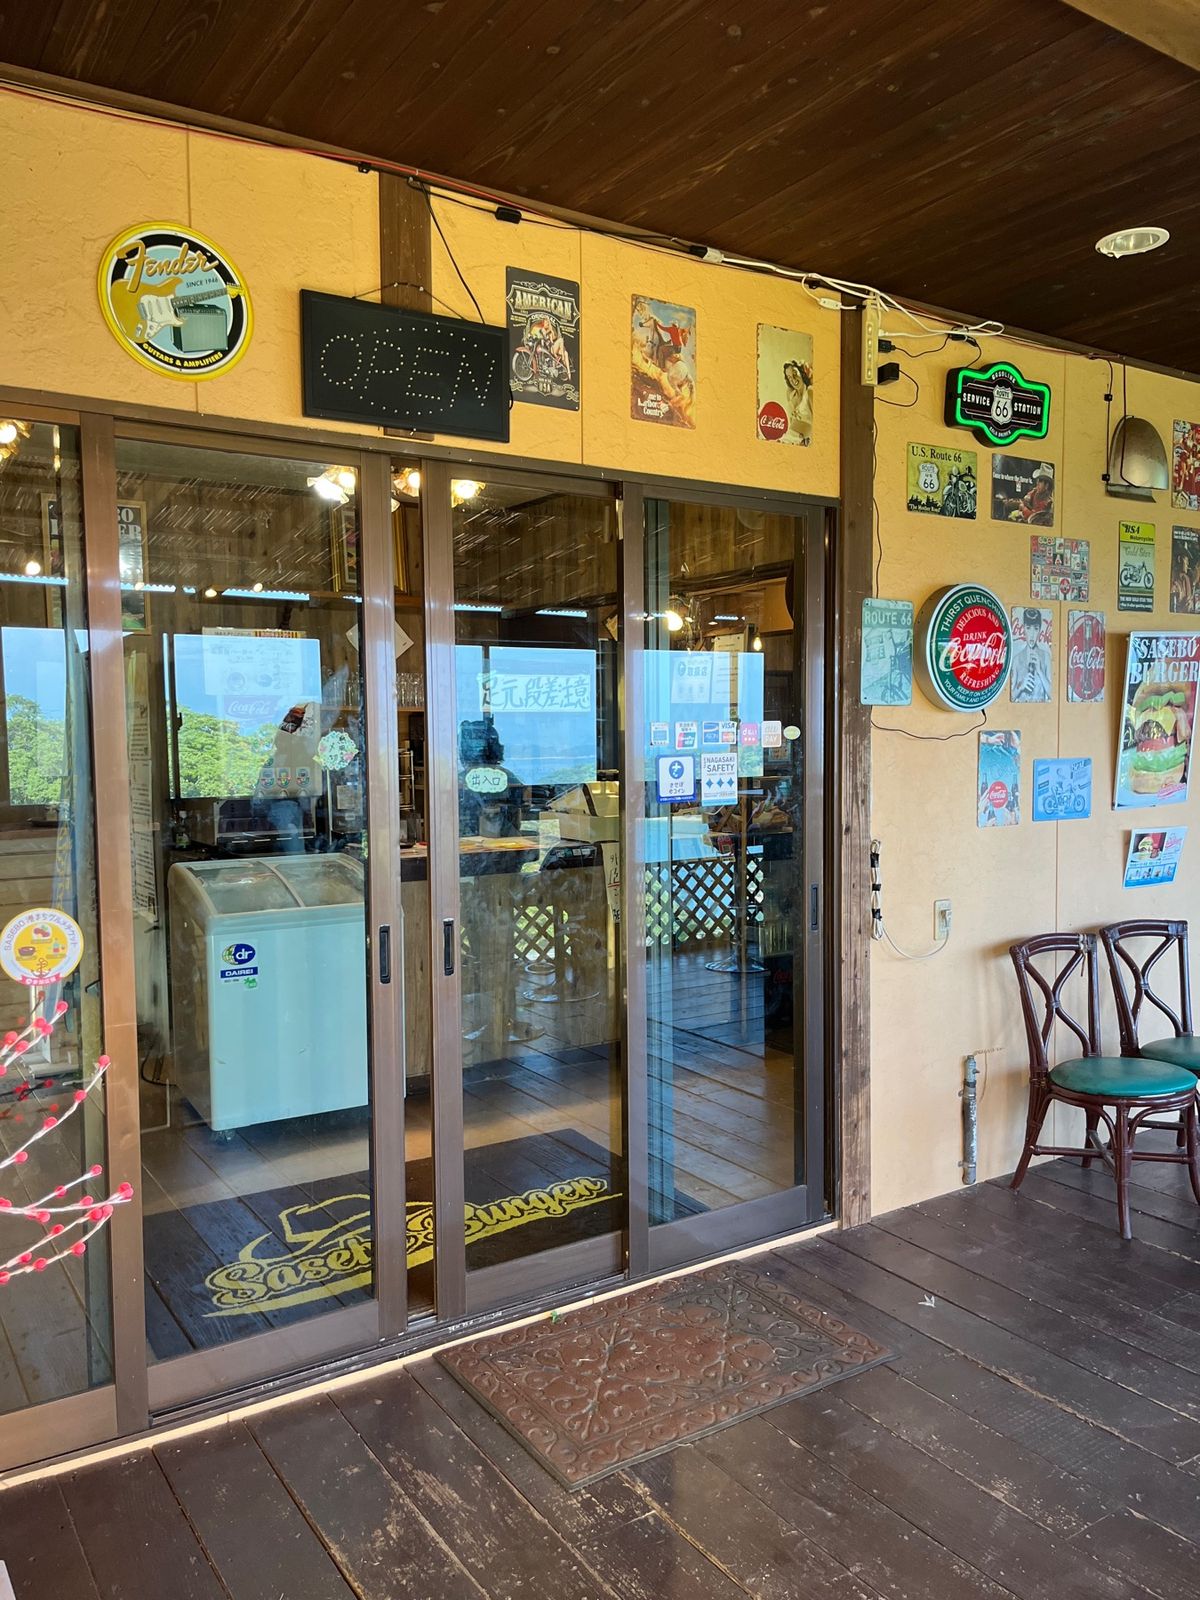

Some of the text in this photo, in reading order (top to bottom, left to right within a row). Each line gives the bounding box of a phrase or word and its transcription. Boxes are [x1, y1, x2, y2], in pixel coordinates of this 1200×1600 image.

[115, 240, 220, 293] Fender
[186, 279, 204, 289] SINCE
[514, 290, 573, 321] AMERICAN
[142, 343, 224, 368] GUITARS & AMPLIFIERS
[321, 334, 496, 408] OPEN
[962, 392, 991, 406] SERVICE
[995, 401, 1009, 418] 66
[1014, 402, 1041, 415] STATION
[911, 446, 962, 463] U.S. Route 66
[924, 479, 935, 489] 66
[1124, 523, 1140, 534] BSA
[865, 611, 912, 626] ROUTE 66
[940, 595, 1005, 632] THIRST QUENCHING
[957, 608, 1000, 632] DELICIOUS AND
[963, 631, 987, 641] DRINK
[939, 632, 1008, 672] Coca-Cola
[1069, 645, 1105, 669] Coca-Cola
[1139, 637, 1198, 659] SASEBO
[960, 667, 1000, 689] REFRESHING
[1130, 660, 1199, 685] BURGER
[482, 676, 591, 709] 足元段差注意
[943, 679, 956, 693] YOUR
[953, 690, 970, 702] FAMILY
[957, 685, 969, 696] KEEP
[765, 735, 777, 743] PAY
[706, 763, 735, 773] SAFETY
[472, 775, 501, 786] 出入口
[236, 948, 253, 960] dr
[225, 969, 254, 977] DAIREI
